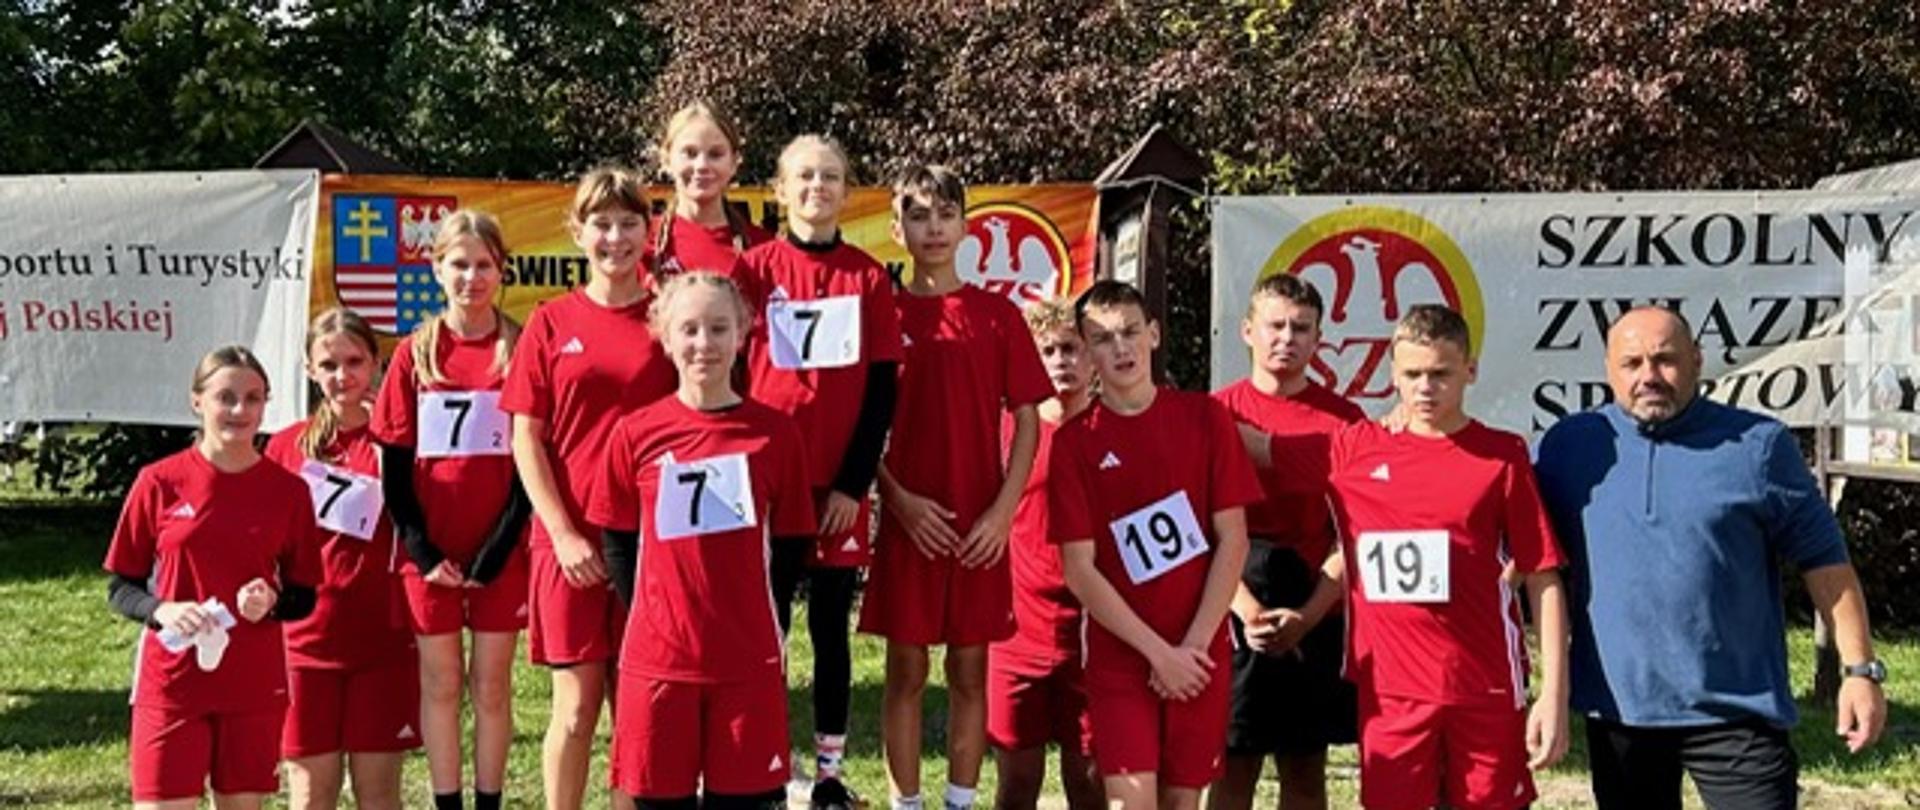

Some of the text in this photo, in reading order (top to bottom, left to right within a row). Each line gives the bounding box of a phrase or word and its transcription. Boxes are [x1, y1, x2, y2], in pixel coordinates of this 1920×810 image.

[1538, 212, 1913, 269] SZKOLNY
[105, 244, 119, 276] i
[127, 244, 305, 290] Turystyki
[22, 300, 174, 342] Polskiej
[794, 310, 822, 361] 7
[1534, 296, 1881, 364] ZĄZE
[444, 400, 502, 448] 7 2
[319, 473, 353, 519] 7
[678, 470, 706, 527] 7
[1125, 510, 1182, 571] 19
[1367, 540, 1422, 594] 19
